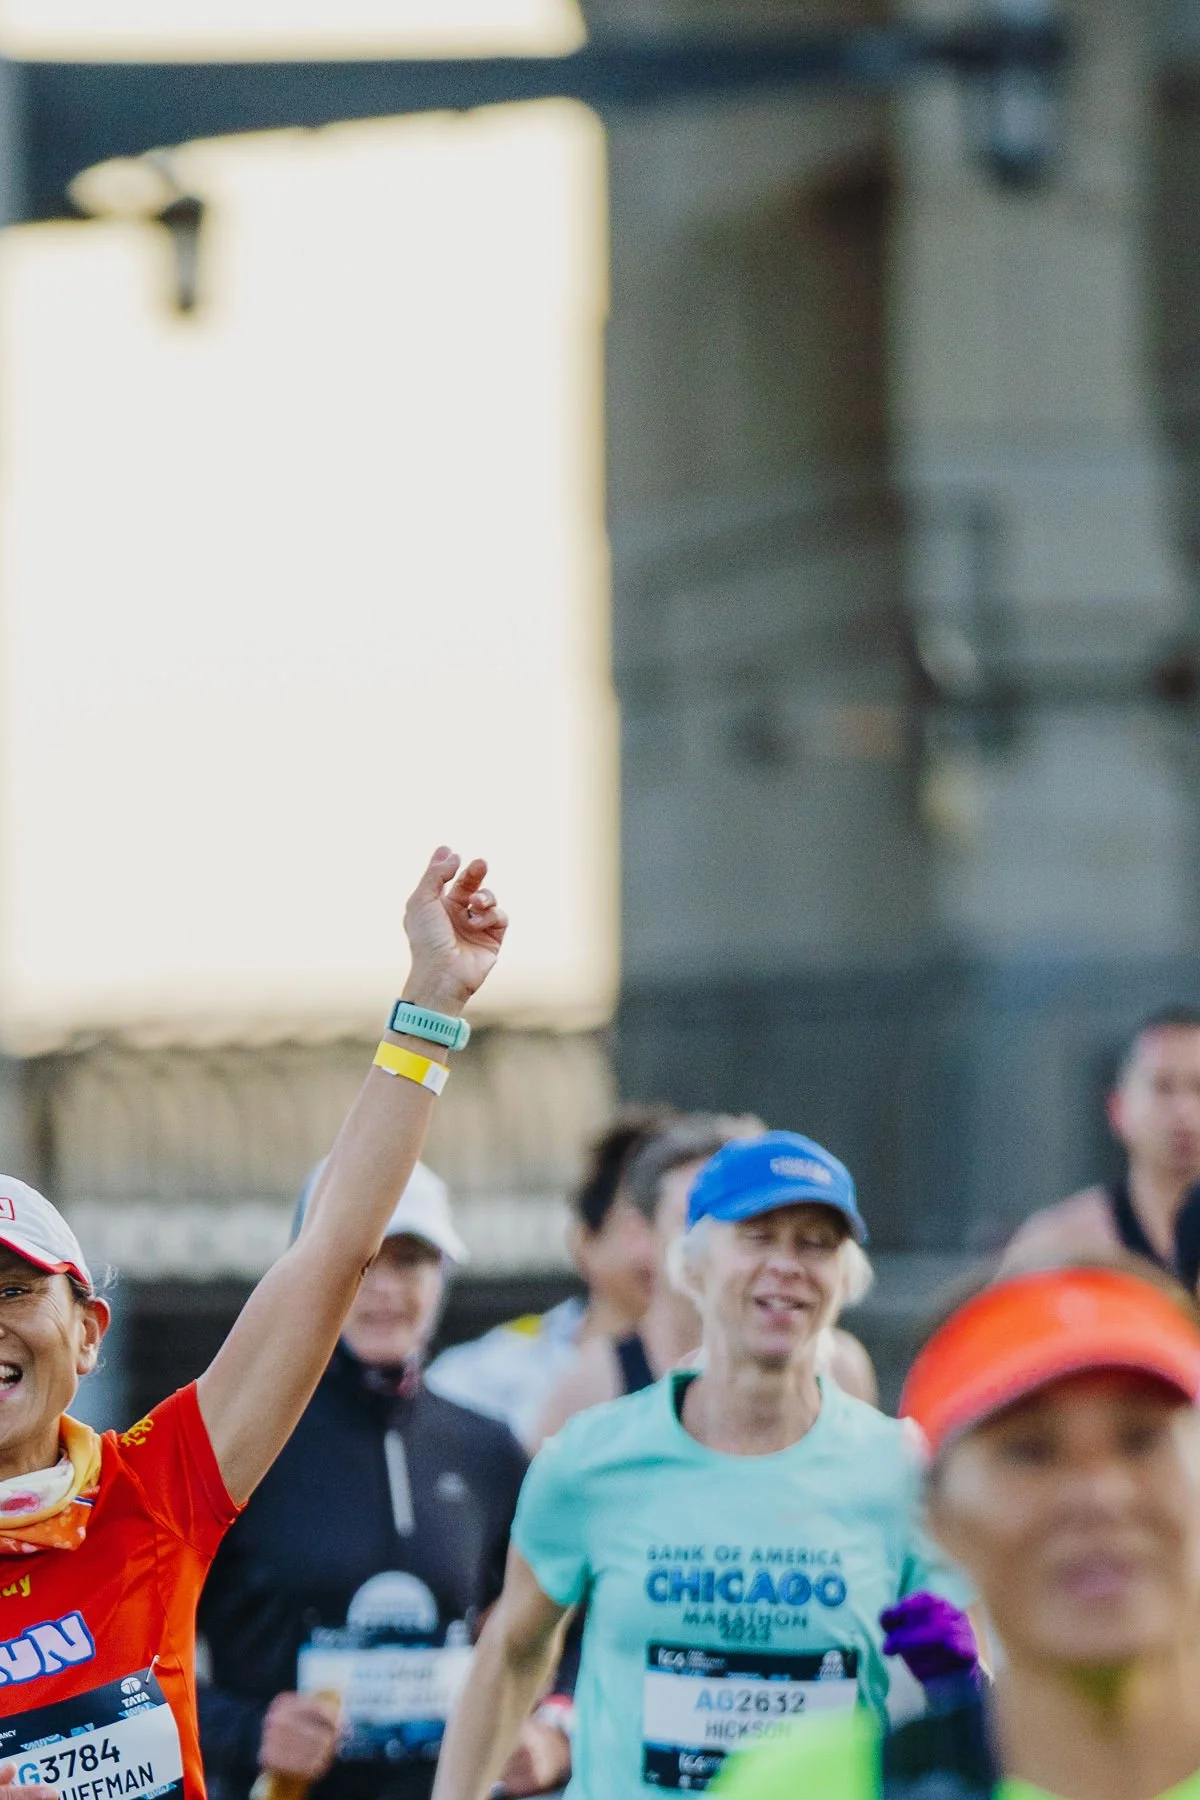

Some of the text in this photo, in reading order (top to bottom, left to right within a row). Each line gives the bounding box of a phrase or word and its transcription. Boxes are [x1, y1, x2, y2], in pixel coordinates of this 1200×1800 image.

[647, 1545, 841, 1565] BANK OF AMERICA
[645, 1566, 846, 1607] CHICAGO
[682, 1608, 807, 1628] MARATHON
[121, 1691, 151, 1708] TATA
[696, 1688, 806, 1714] AG2632
[13, 1738, 120, 1785] G3784
